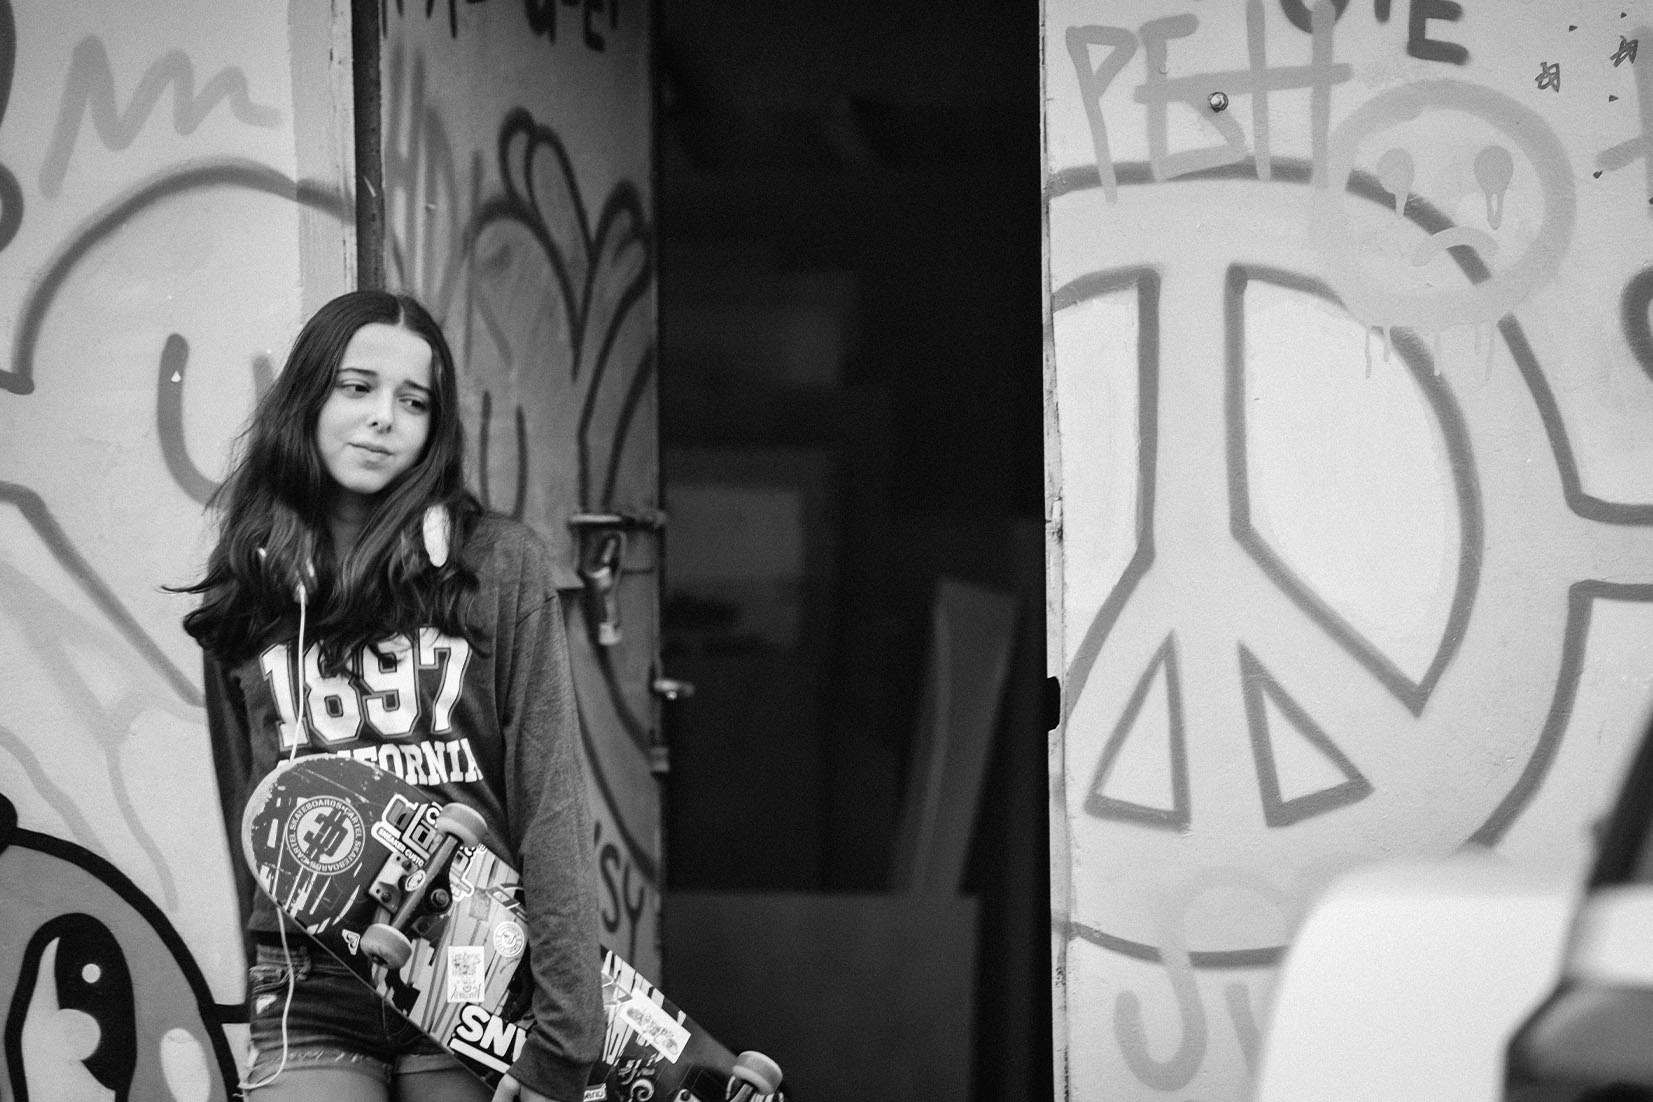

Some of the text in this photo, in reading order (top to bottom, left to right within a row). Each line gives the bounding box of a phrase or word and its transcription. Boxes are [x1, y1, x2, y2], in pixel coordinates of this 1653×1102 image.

[259, 626, 472, 752] 1897
[289, 799, 343, 831] SKATEBOARDS
[377, 827, 408, 854] SNEAKER
